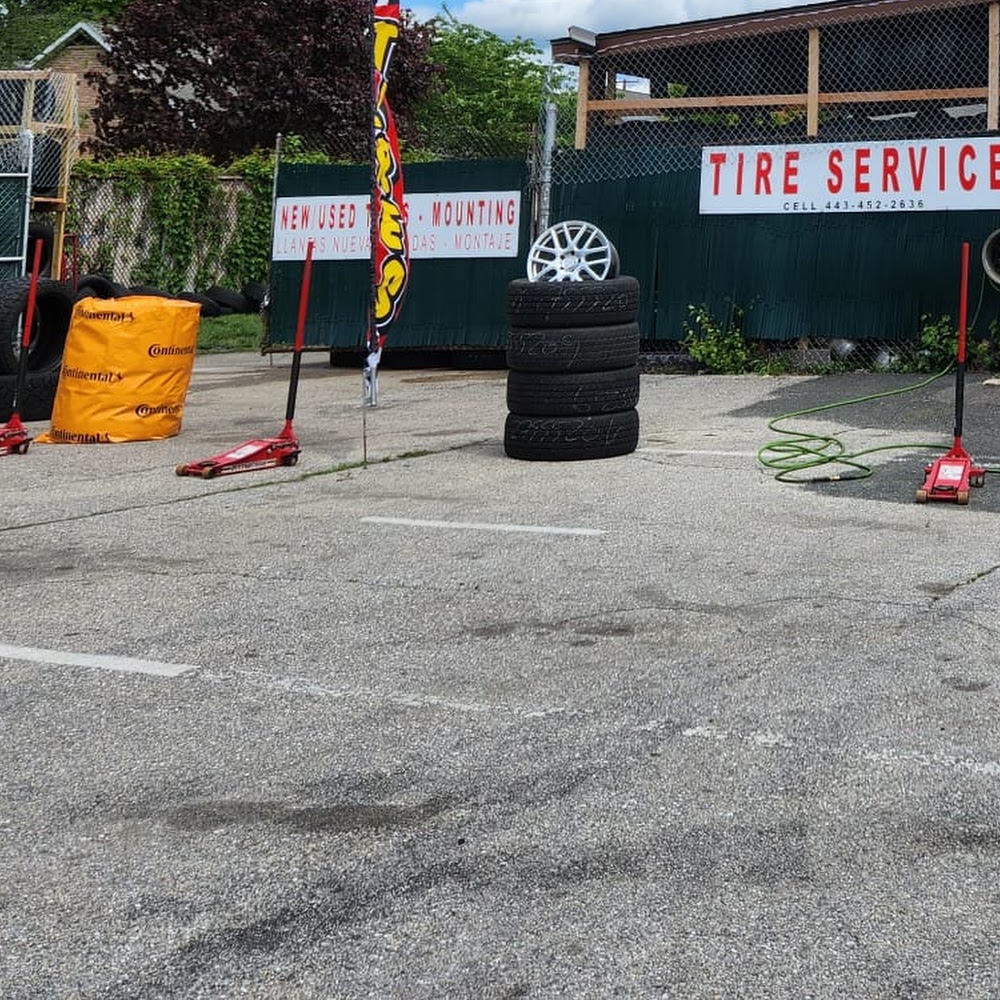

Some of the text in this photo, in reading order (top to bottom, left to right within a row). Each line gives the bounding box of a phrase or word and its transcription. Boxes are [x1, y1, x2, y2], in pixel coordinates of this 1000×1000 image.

[709, 150, 800, 196] TIRE
[432, 199, 516, 227] MOUNTING
[783, 199, 925, 211] CELL 443-452-2636
[333, 235, 371, 254] NUEVA
